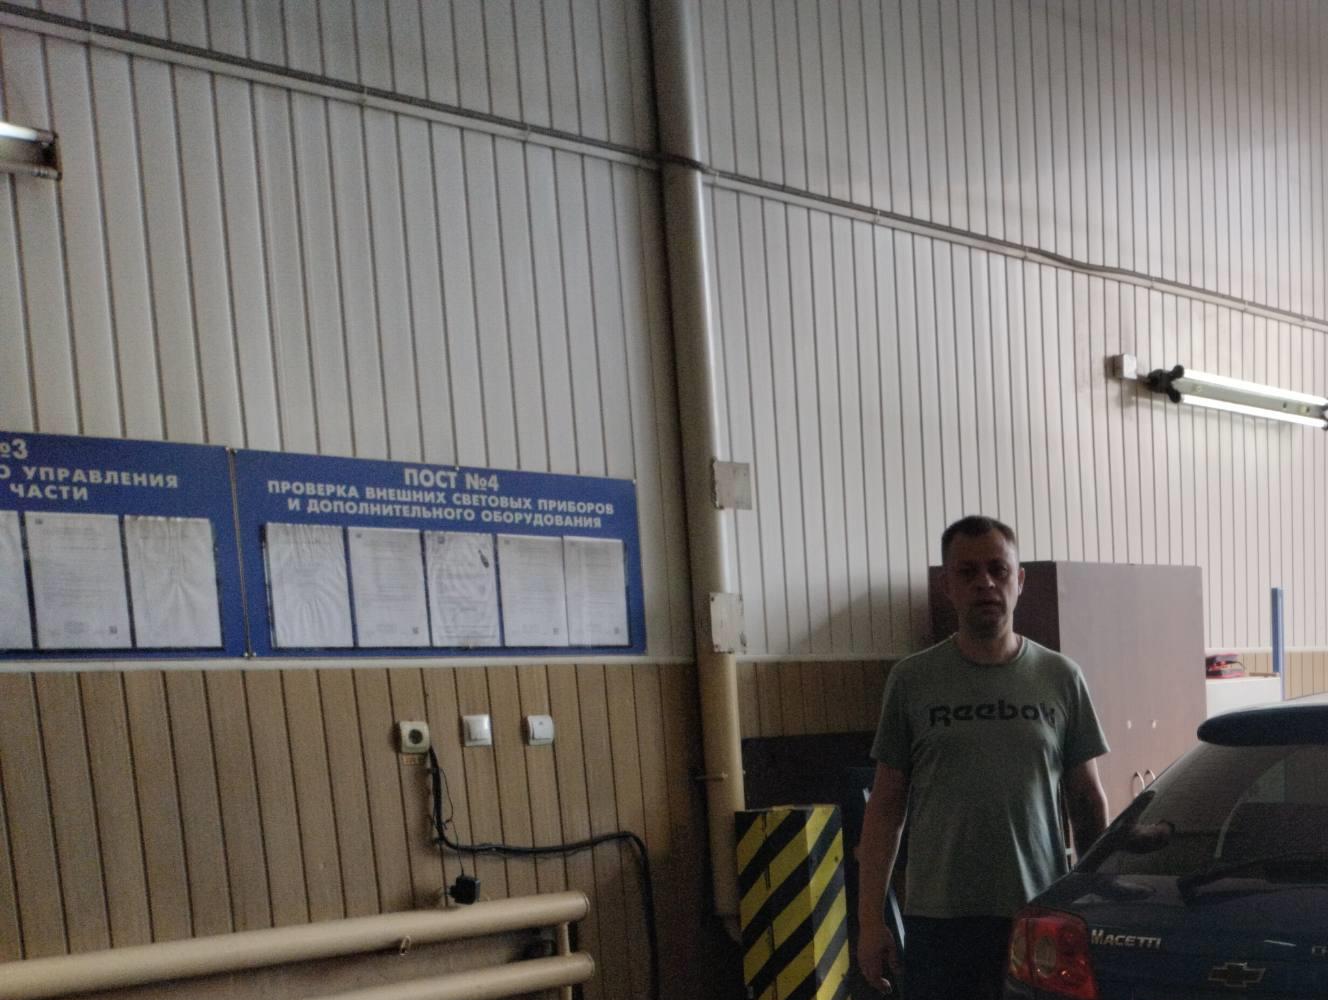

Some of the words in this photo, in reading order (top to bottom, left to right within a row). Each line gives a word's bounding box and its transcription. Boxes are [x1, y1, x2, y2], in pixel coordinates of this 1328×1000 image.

[23, 466, 179, 489] УПРАВЛЕНИЯ
[404, 468, 458, 489] ПОСТ
[465, 472, 499, 491] №4
[10, 483, 88, 501] ЧАСТИ
[267, 480, 359, 499] ПРОВЕРКА
[365, 487, 447, 504] ВНЕШНИХ
[452, 493, 532, 511] СВЕТОВЫХ
[538, 499, 614, 515] ПРИБОРОВ
[287, 498, 301, 511] И
[307, 499, 475, 521] ДОПОЛНИТЕЛЬНОГО
[481, 510, 602, 528] ОБОРУДОВАНИЯ
